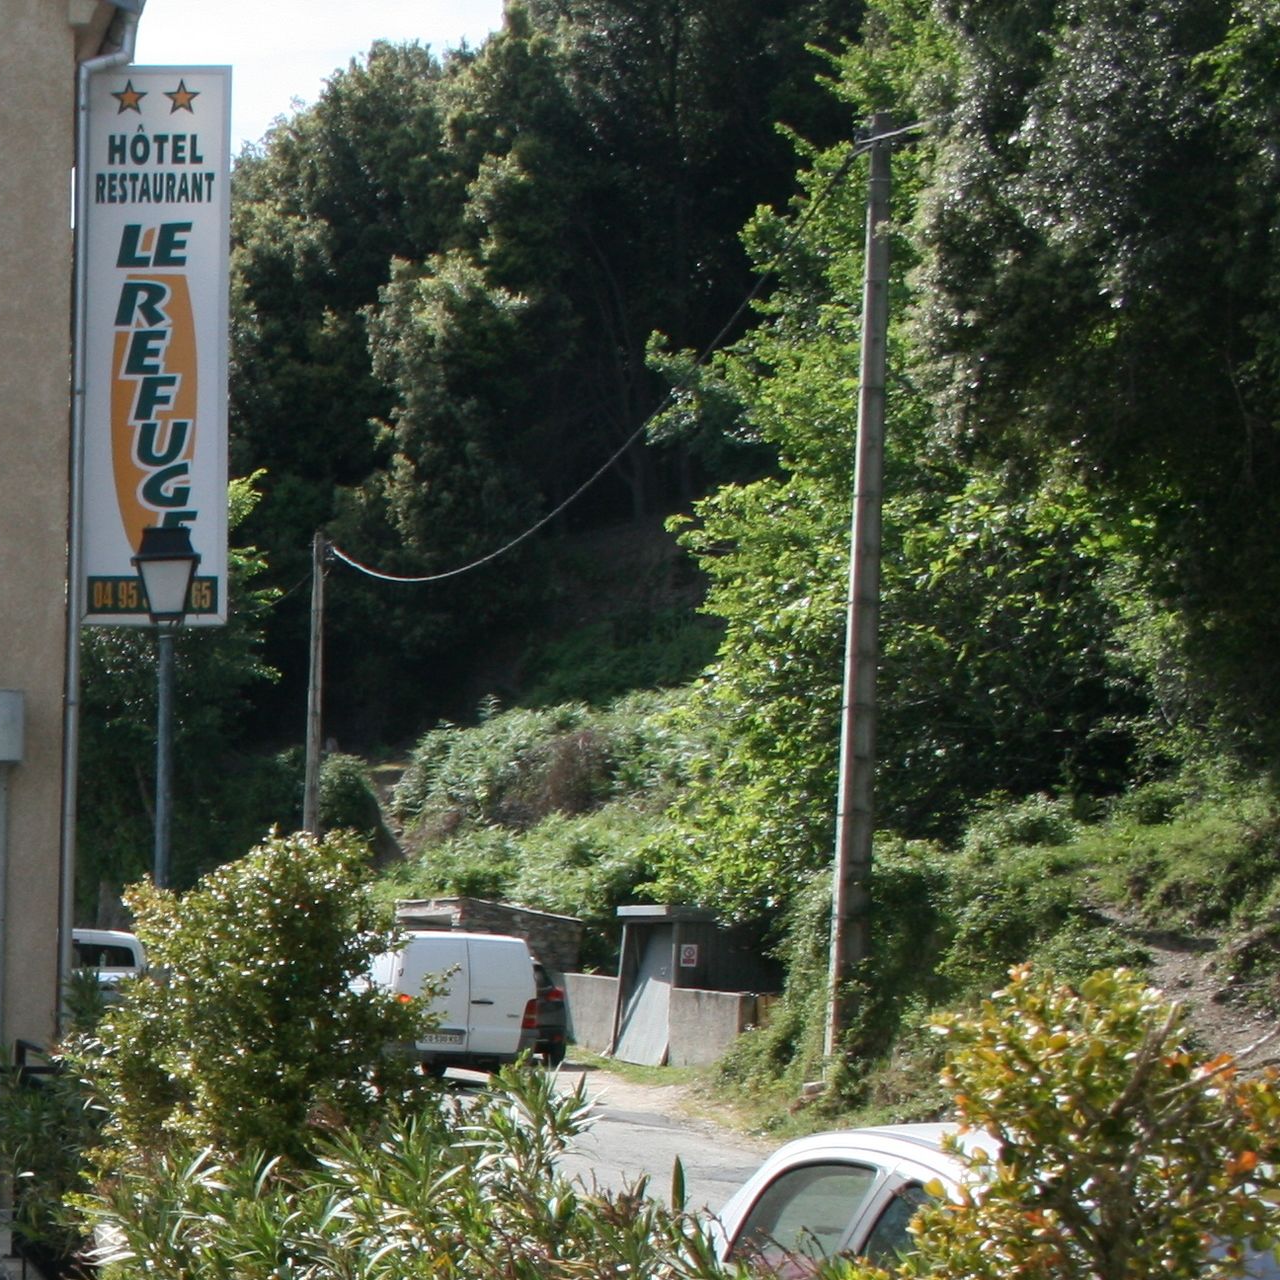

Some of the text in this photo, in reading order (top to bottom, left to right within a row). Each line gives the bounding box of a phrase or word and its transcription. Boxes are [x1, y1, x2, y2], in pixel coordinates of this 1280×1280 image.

[108, 124, 204, 165] HÔTEL
[95, 172, 215, 204] RESTAURANT
[116, 222, 193, 268] LE
[119, 581, 138, 608] 95
